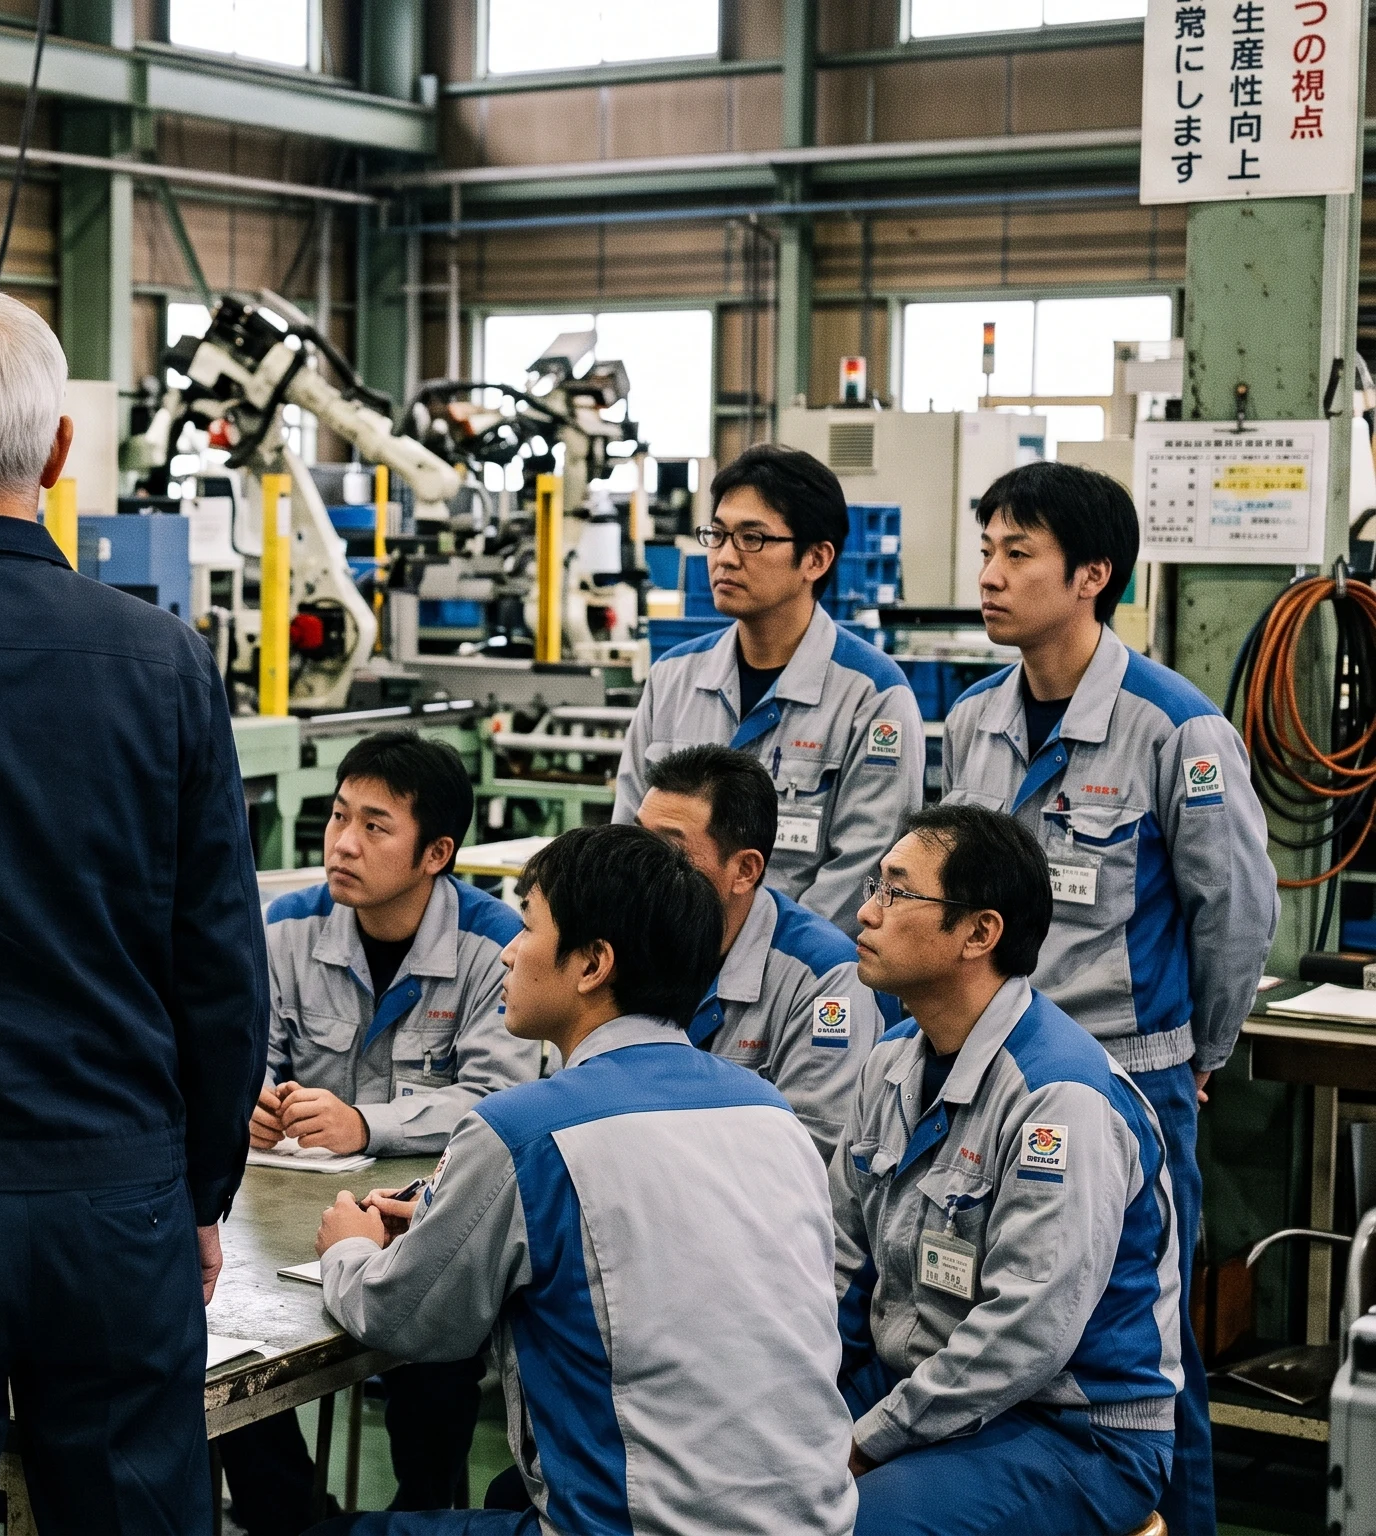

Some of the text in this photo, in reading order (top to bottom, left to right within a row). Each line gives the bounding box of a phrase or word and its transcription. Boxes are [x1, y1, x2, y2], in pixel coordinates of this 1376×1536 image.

[1228, 1, 1265, 180] 生産性向上
